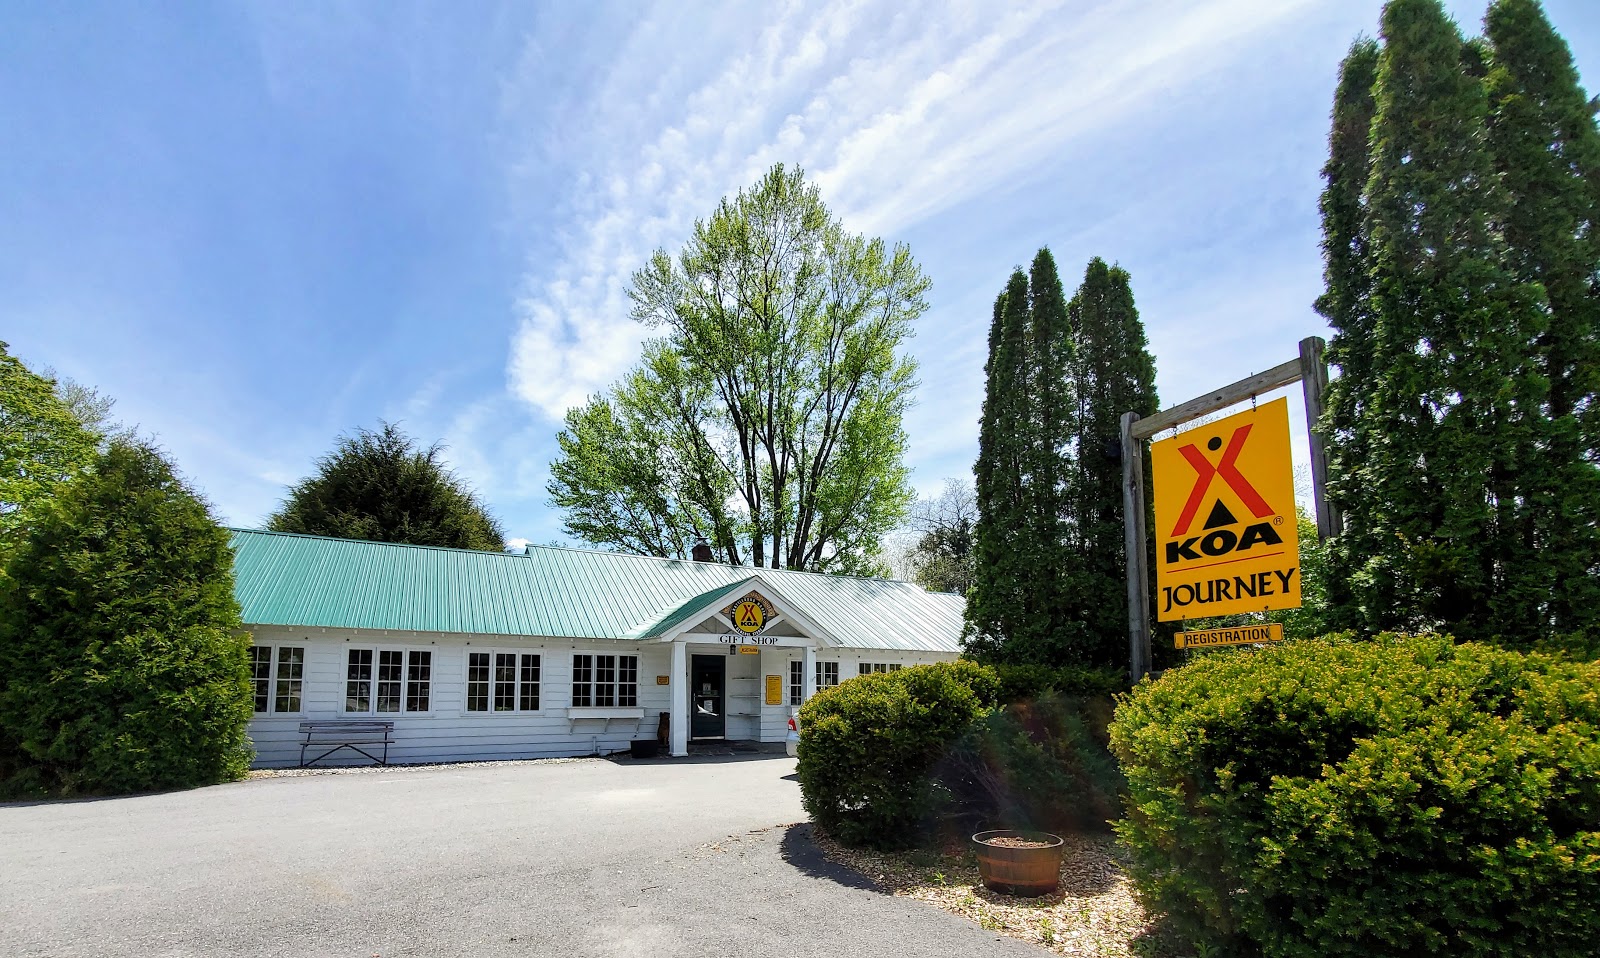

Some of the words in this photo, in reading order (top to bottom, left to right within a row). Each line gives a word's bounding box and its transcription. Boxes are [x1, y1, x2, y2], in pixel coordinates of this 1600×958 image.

[1165, 522, 1283, 564] KOA
[1162, 567, 1296, 612] JOURNEY
[719, 635, 746, 643] GIFT
[1185, 628, 1270, 645] REGISTRATION
